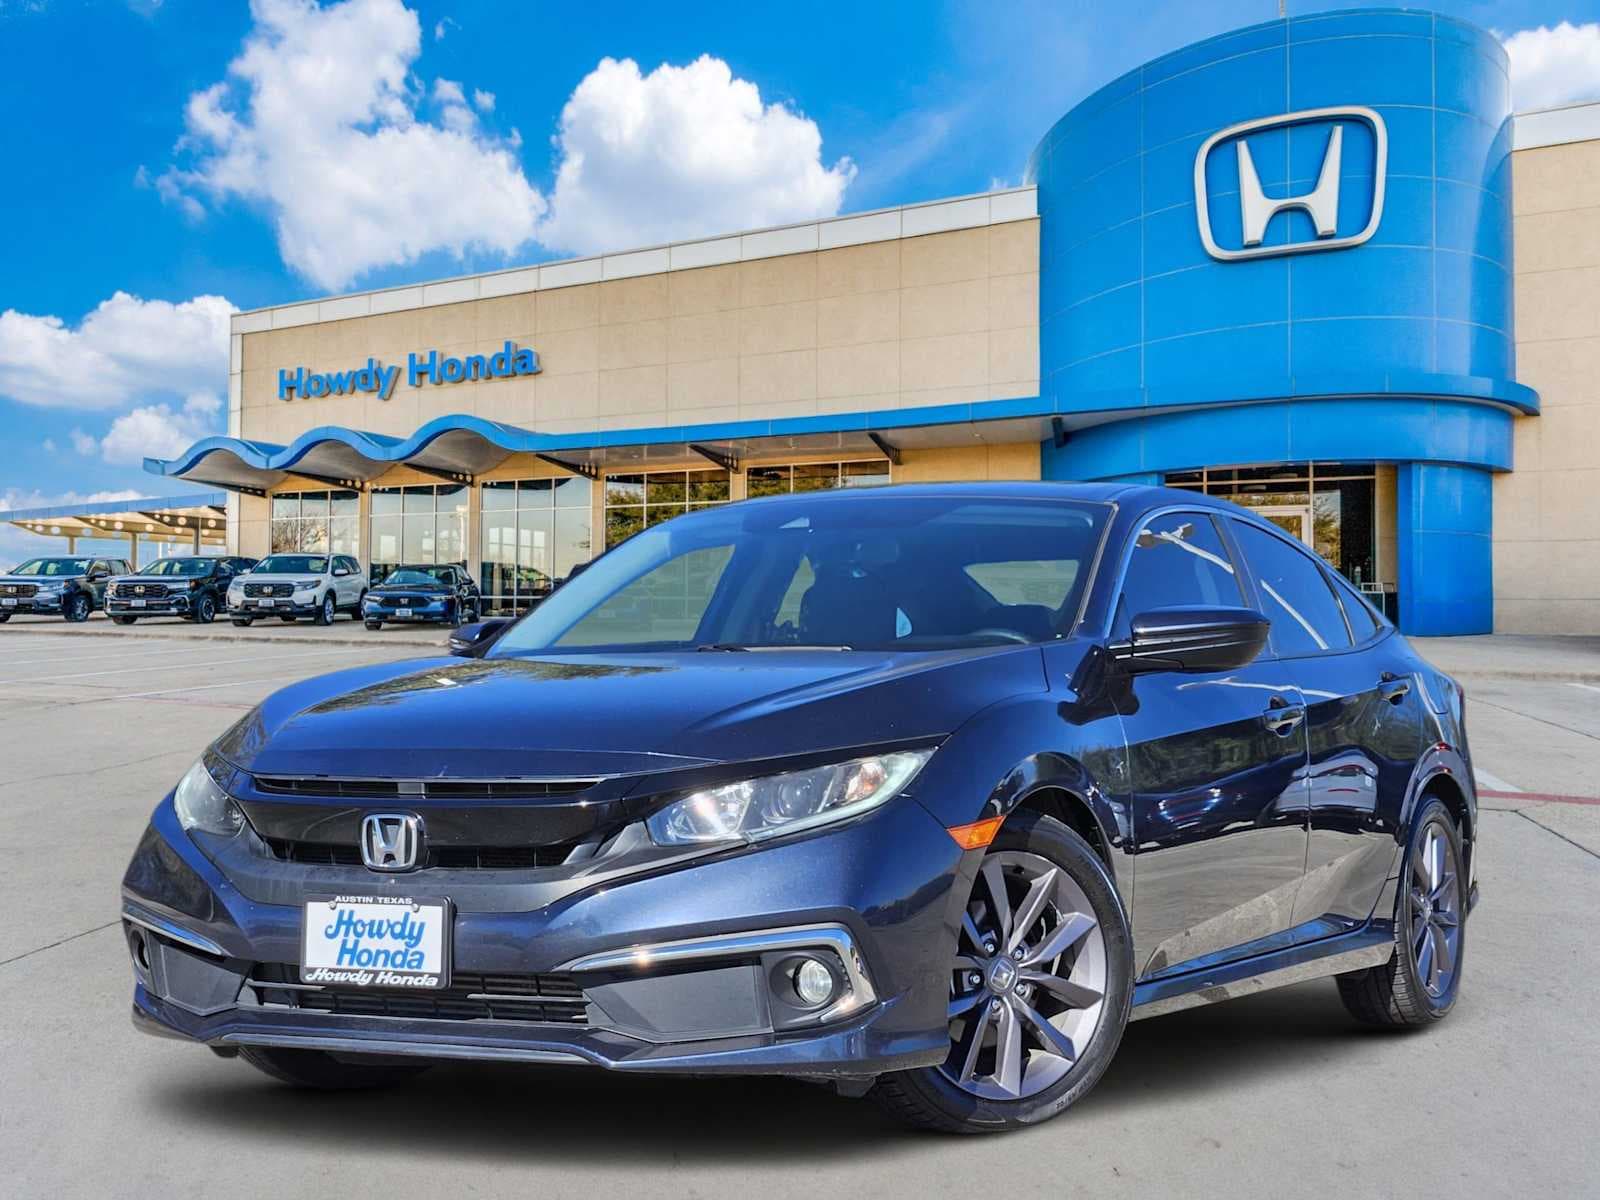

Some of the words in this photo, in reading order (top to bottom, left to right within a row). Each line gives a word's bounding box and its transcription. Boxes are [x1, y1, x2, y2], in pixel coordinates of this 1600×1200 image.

[278, 357, 401, 401] Howdy
[408, 340, 541, 388] Honda
[334, 895, 373, 904] AUSTIN
[376, 896, 413, 905] TEXAS
[324, 909, 426, 948] Howdy
[336, 938, 425, 970] Honda
[305, 968, 374, 985] Howdy
[375, 970, 438, 986] Honda
